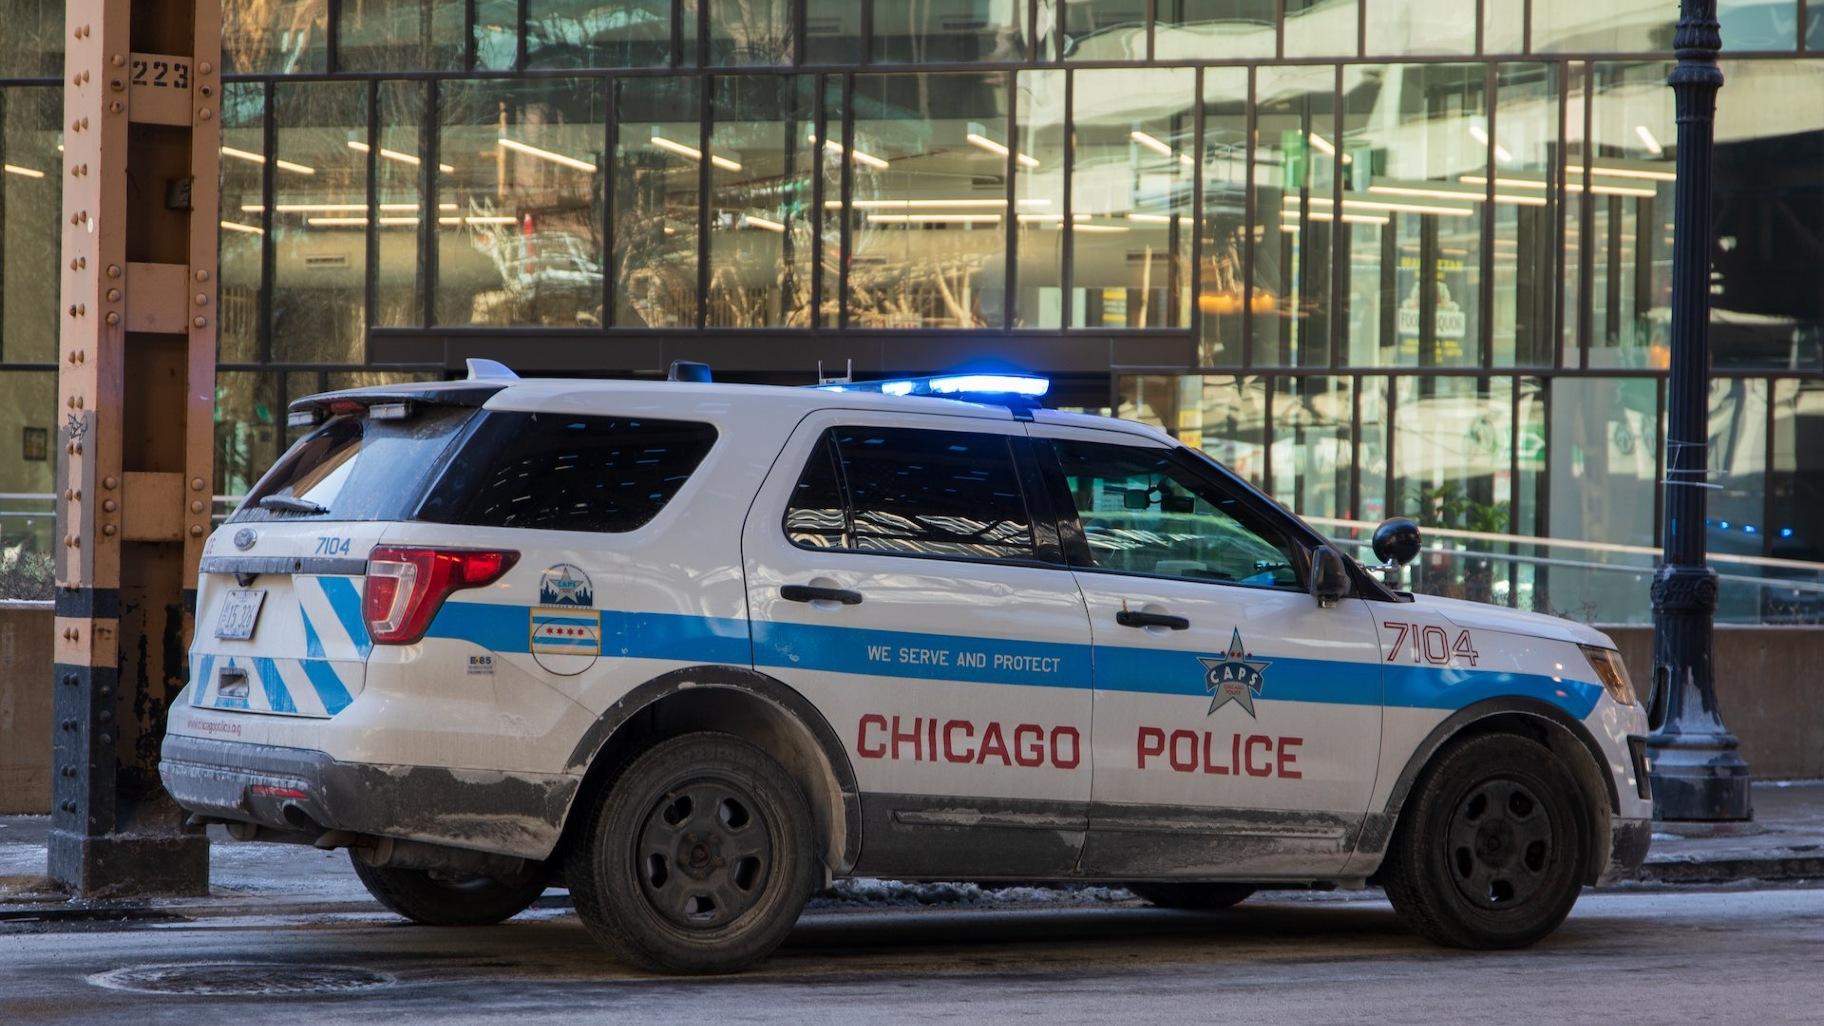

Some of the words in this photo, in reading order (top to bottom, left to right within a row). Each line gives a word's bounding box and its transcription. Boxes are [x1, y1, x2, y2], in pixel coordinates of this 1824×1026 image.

[132, 61, 188, 88] 223
[315, 536, 351, 555] 7104
[1383, 621, 1479, 667] 7104
[867, 645, 891, 662] WE
[899, 647, 949, 666] SERVE
[957, 652, 986, 668] AND
[994, 654, 1061, 673] PROTECT
[1210, 666, 1259, 685] CAPS
[856, 713, 1081, 770] CHICAGO
[1137, 725, 1304, 780] POLICE
